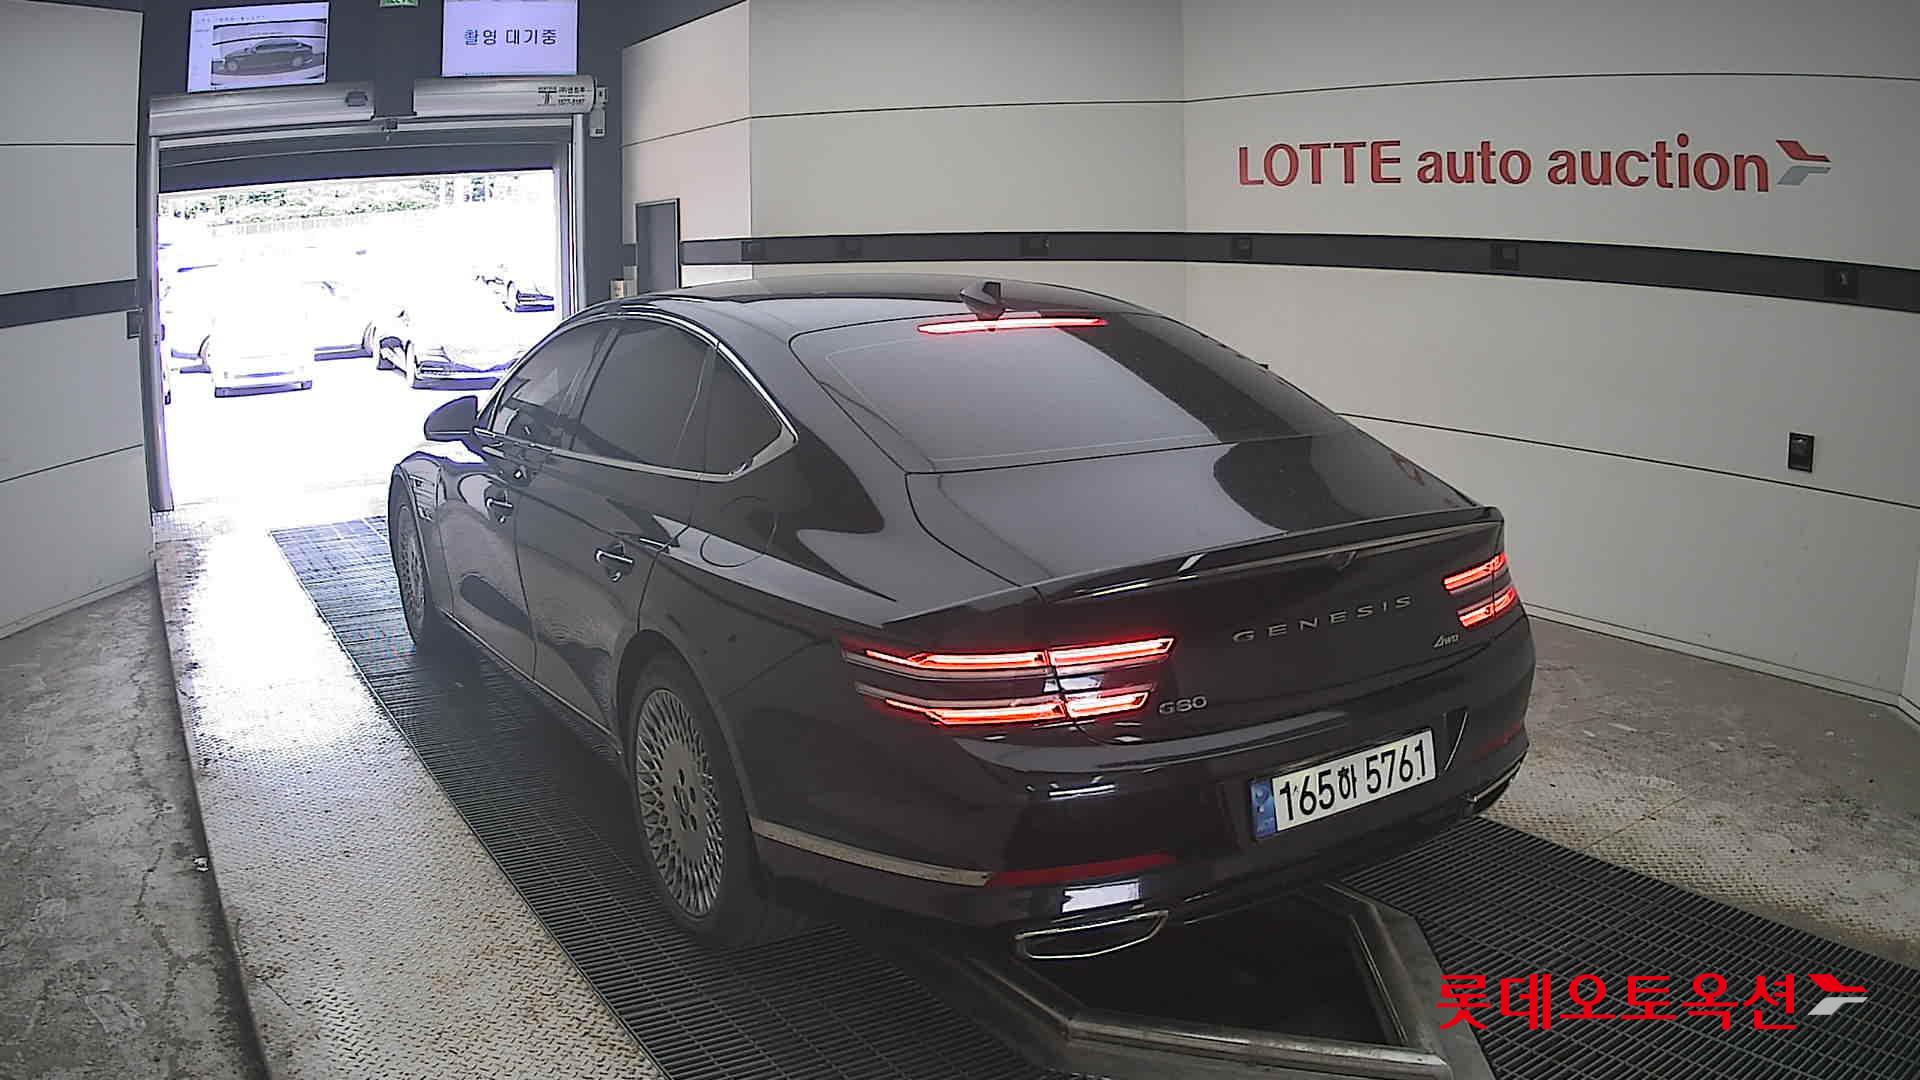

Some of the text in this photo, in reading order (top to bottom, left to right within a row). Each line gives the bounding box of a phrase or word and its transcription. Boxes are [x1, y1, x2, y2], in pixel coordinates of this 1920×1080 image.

[464, 29, 557, 46] 촬영 대기중
[1238, 133, 1769, 192] LOTTE auto auction
[1232, 596, 1412, 642] GENESIS
[1159, 695, 1208, 715] G80
[1279, 739, 1427, 821] 165하 5761
